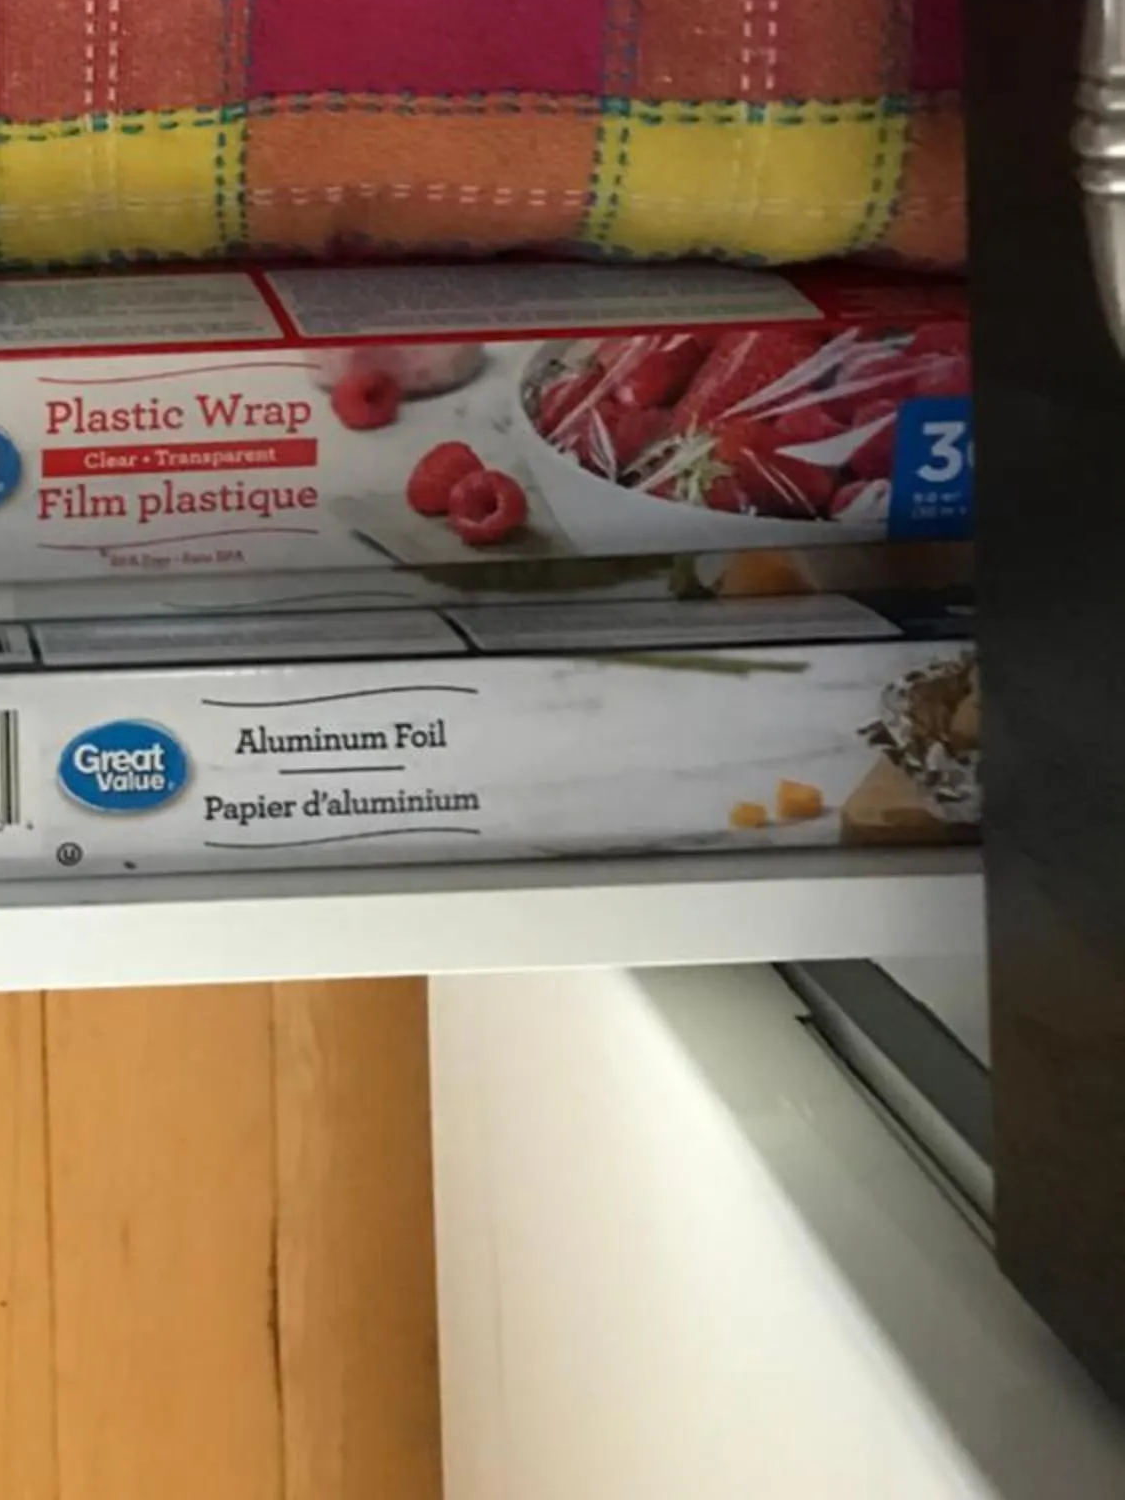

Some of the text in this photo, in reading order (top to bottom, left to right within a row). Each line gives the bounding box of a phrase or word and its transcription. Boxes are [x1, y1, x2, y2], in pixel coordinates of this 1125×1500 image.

[46, 392, 312, 434] Plastic Wrap
[83, 447, 276, 469] Clear Transparent
[916, 420, 974, 482] 3
[38, 479, 318, 523] Film plastique
[235, 719, 448, 755] Aluminum Foil
[74, 743, 166, 774] Great
[97, 770, 166, 793] Value
[204, 789, 481, 826] Papier d'aluminium
